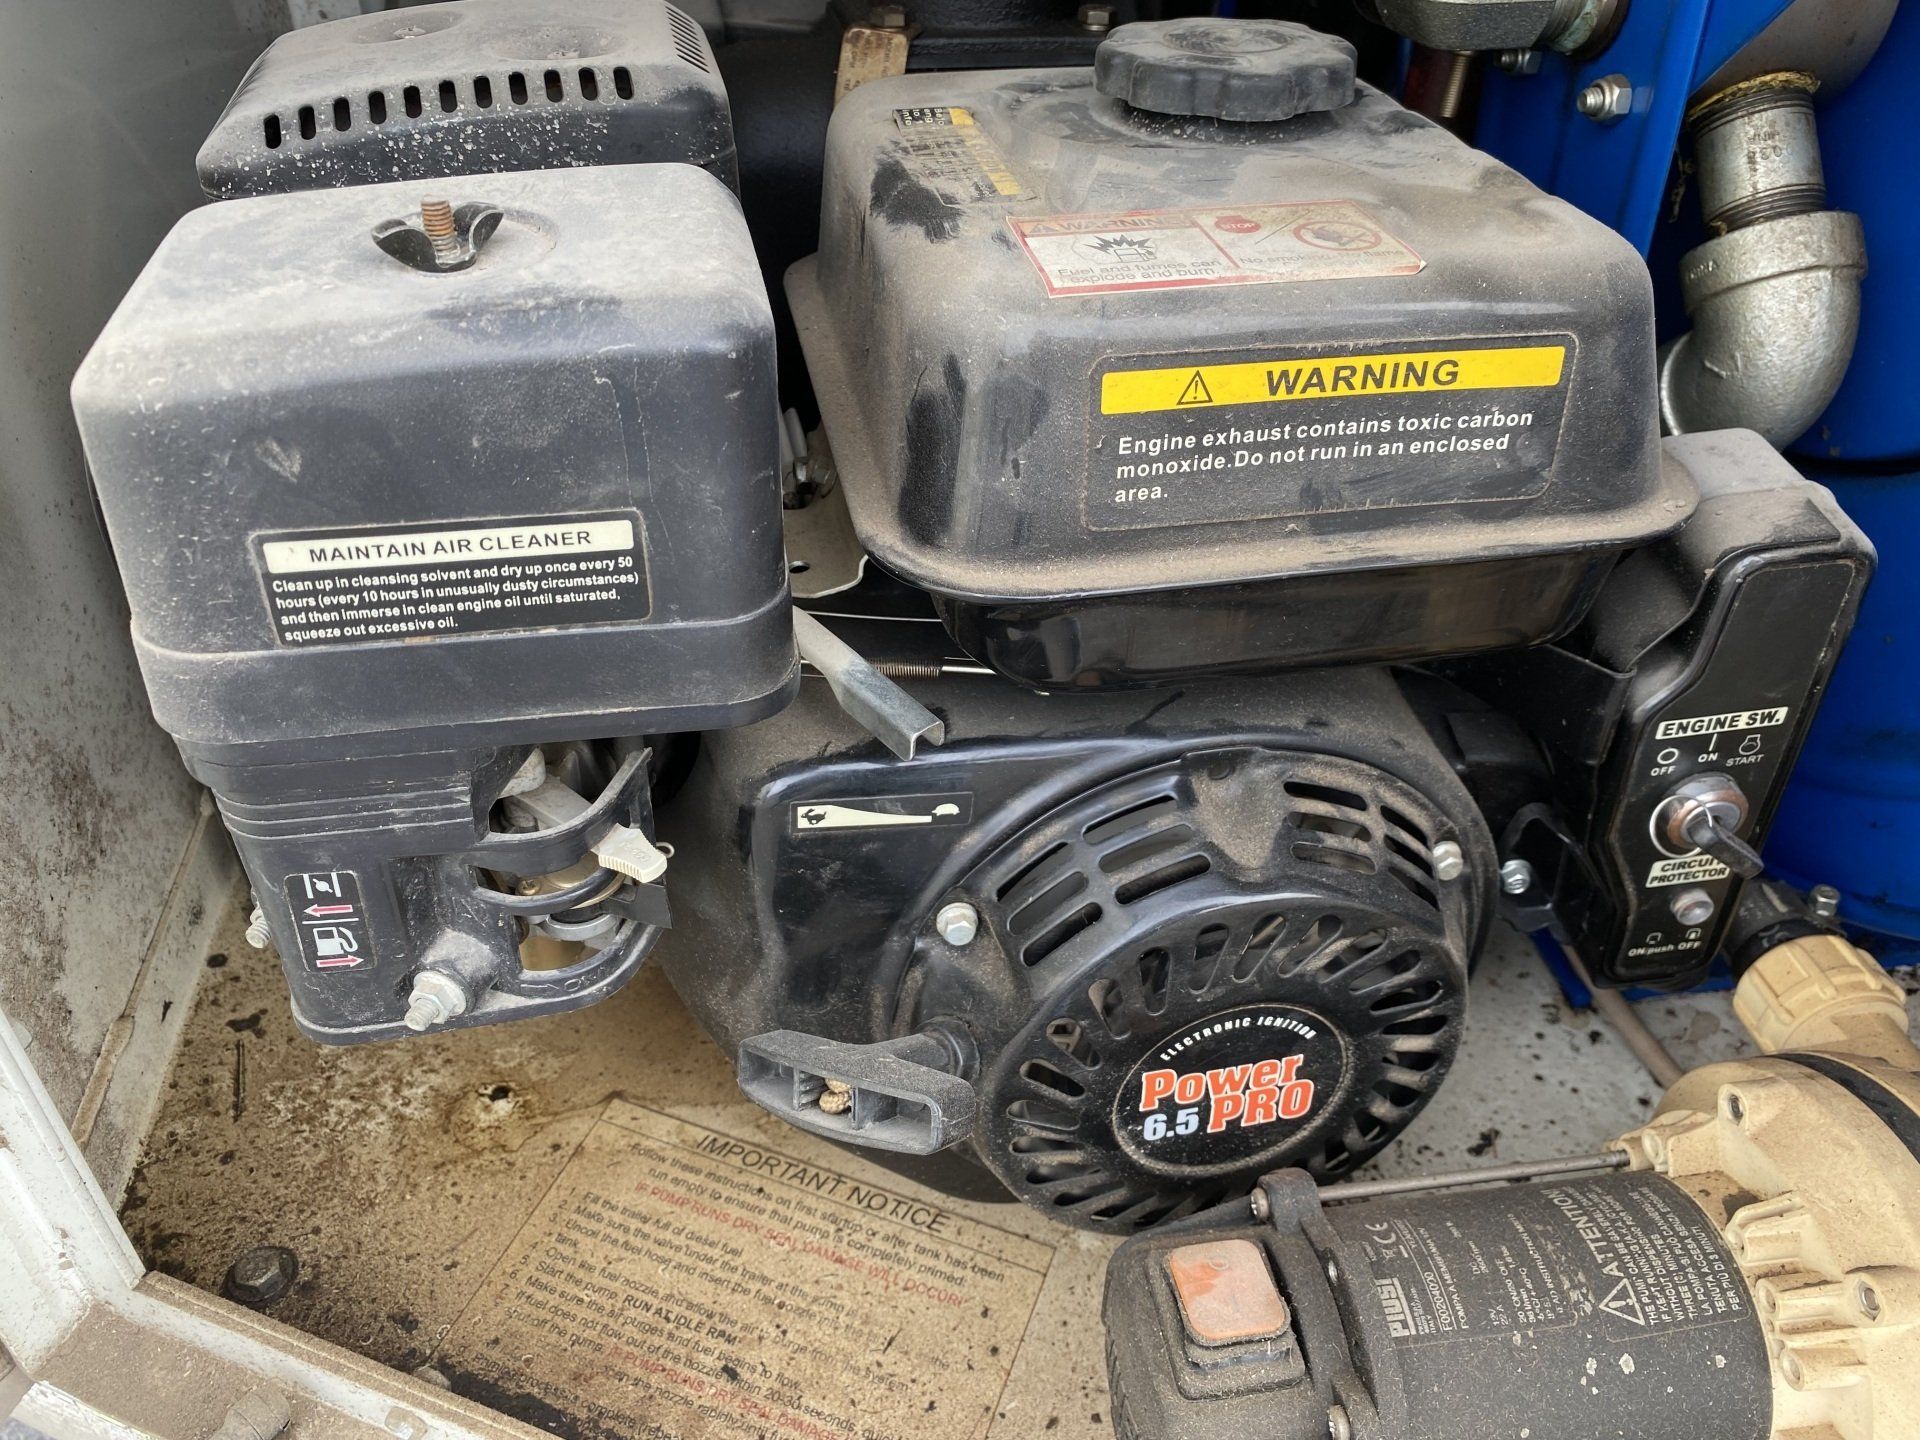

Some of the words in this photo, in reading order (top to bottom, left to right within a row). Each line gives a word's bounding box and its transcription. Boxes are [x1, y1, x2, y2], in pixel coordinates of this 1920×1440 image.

[1058, 265, 1095, 276] Fuel
[1100, 263, 1130, 273] and
[1135, 261, 1186, 271] fumes
[1191, 259, 1222, 267] can
[1070, 270, 1136, 283] explode
[1141, 268, 1170, 278] and
[1265, 358, 1460, 396] WARNING
[1118, 433, 1198, 457] Engine
[1202, 425, 1292, 449] exhaust
[1296, 419, 1393, 442] contains
[1397, 414, 1452, 435] toxic
[1457, 409, 1533, 431] carbon
[1270, 448, 1300, 468] not
[1310, 449, 1347, 465] run
[1352, 443, 1372, 461] in
[1377, 445, 1401, 460] an
[1409, 432, 1509, 457] enclosed
[1114, 486, 1169, 503] area.
[310, 539, 426, 563] MAINTAIN
[433, 536, 472, 554] AIR
[480, 528, 593, 551] CLEANER
[272, 578, 313, 592] Clean
[315, 579, 334, 592] up
[336, 574, 349, 588] in
[351, 570, 419, 587] cleansing
[420, 565, 471, 582] solvent
[473, 563, 498, 579] and
[500, 563, 522, 579] dry
[524, 565, 542, 578] up
[544, 562, 577, 574] once
[579, 560, 615, 573] every
[617, 554, 633, 569] 50
[276, 594, 316, 608] hours
[318, 591, 360, 609] (every
[362, 588, 377, 603] 10
[380, 587, 419, 601] hours
[421, 585, 434, 599] in
[436, 580, 501, 598] unusually
[502, 578, 539, 594] dusty
[541, 570, 640, 591] circumstances)
[281, 609, 305, 625] and
[306, 608, 337, 623] then
[341, 606, 400, 621] immerse
[402, 602, 416, 616] in
[418, 600, 455, 615] clean
[456, 596, 501, 614] engine
[504, 594, 521, 609] oil
[523, 592, 553, 607] until
[285, 627, 341, 644] squeeze
[343, 621, 366, 636] out
[368, 616, 434, 634] excessive
[437, 614, 459, 629] oil.
[1661, 713, 1740, 737] ENGINE
[1745, 710, 1781, 727] SW.
[1650, 765, 1676, 777] OFF
[1697, 752, 1718, 763] ON
[1725, 754, 1765, 767] START
[1649, 867, 1728, 885] PROTECTOR
[1677, 940, 1701, 950] OFF
[1159, 1016, 1251, 1062] ELECTRONIC
[1256, 1016, 1318, 1040] IGNITION
[1139, 1053, 1304, 1112] Power
[1143, 1107, 1200, 1141] 6.5
[1207, 1079, 1315, 1134] PRO
[694, 1132, 847, 1198] IMPORTANT
[845, 1183, 951, 1234] NOTICE
[581, 1190, 602, 1205] Fill
[599, 1197, 619, 1212] the
[618, 1204, 652, 1224] trailer
[651, 1216, 673, 1231] full
[670, 1224, 687, 1236] of
[683, 1227, 721, 1249] diesel
[718, 1240, 745, 1258] fuel
[628, 1143, 668, 1164] Follow
[667, 1157, 703, 1177] these
[703, 1169, 774, 1201] instructions
[773, 1196, 793, 1208] on
[792, 1200, 819, 1217] first
[818, 1210, 862, 1235] startup
[863, 1227, 878, 1238] or
[880, 1232, 910, 1249] after
[912, 1241, 943, 1260] tank
[944, 1252, 968, 1269] has
[969, 1260, 1005, 1282] been
[646, 1167, 668, 1181] run
[669, 1175, 707, 1197] empty
[708, 1187, 723, 1200] to
[722, 1194, 767, 1216] ensure
[767, 1208, 794, 1225] that
[792, 1219, 831, 1241] pump
[832, 1230, 845, 1243] is
[845, 1238, 916, 1272] completely
[1664, 1212, 1689, 1237] SENZA
[1613, 1241, 1628, 1254] BE
[1621, 1254, 1639, 1274] CAN
[1648, 1233, 1679, 1270] MINUTES
[1681, 1237, 1711, 1273] ACCESA
[1711, 1260, 1725, 1270] DI
[534, 1258, 565, 1278] Start
[563, 1269, 584, 1286] the
[622, 1292, 655, 1313] RUN
[652, 1304, 674, 1320] AT
[671, 1311, 706, 1333] IDLE
[696, 1266, 734, 1288] insert
[731, 1279, 753, 1296] the
[752, 1286, 779, 1305] fuel
[1657, 1275, 1686, 1320] WITHOUT
[1676, 1284, 1700, 1318] THREE
[1682, 1267, 1708, 1300] POMPA
[1701, 1273, 1728, 1313] TENUTA
[1724, 1289, 1743, 1310] PER
[1370, 1276, 1411, 1337] PIUSI
[1643, 1304, 1661, 1324] THE
[1659, 1313, 1672, 1323] IF
[1699, 1301, 1714, 1315] LA
[513, 1288, 530, 1302] If
[524, 1292, 550, 1310] fuel
[546, 1301, 579, 1322] does
[577, 1316, 601, 1331] not
[598, 1321, 624, 1340] flow
[624, 1334, 648, 1349] out
[645, 1342, 663, 1355] of
[659, 1345, 683, 1364] the
[682, 1357, 724, 1380] nozzle
[523, 1274, 558, 1296] Make
[556, 1289, 585, 1307] sure
[583, 1297, 605, 1314] the
[604, 1307, 623, 1321] air
[620, 1315, 666, 1338] purges
[666, 1332, 693, 1348] and
[690, 1338, 718, 1358] fuel
[716, 1348, 758, 1374] begins
[758, 1364, 773, 1380] to
